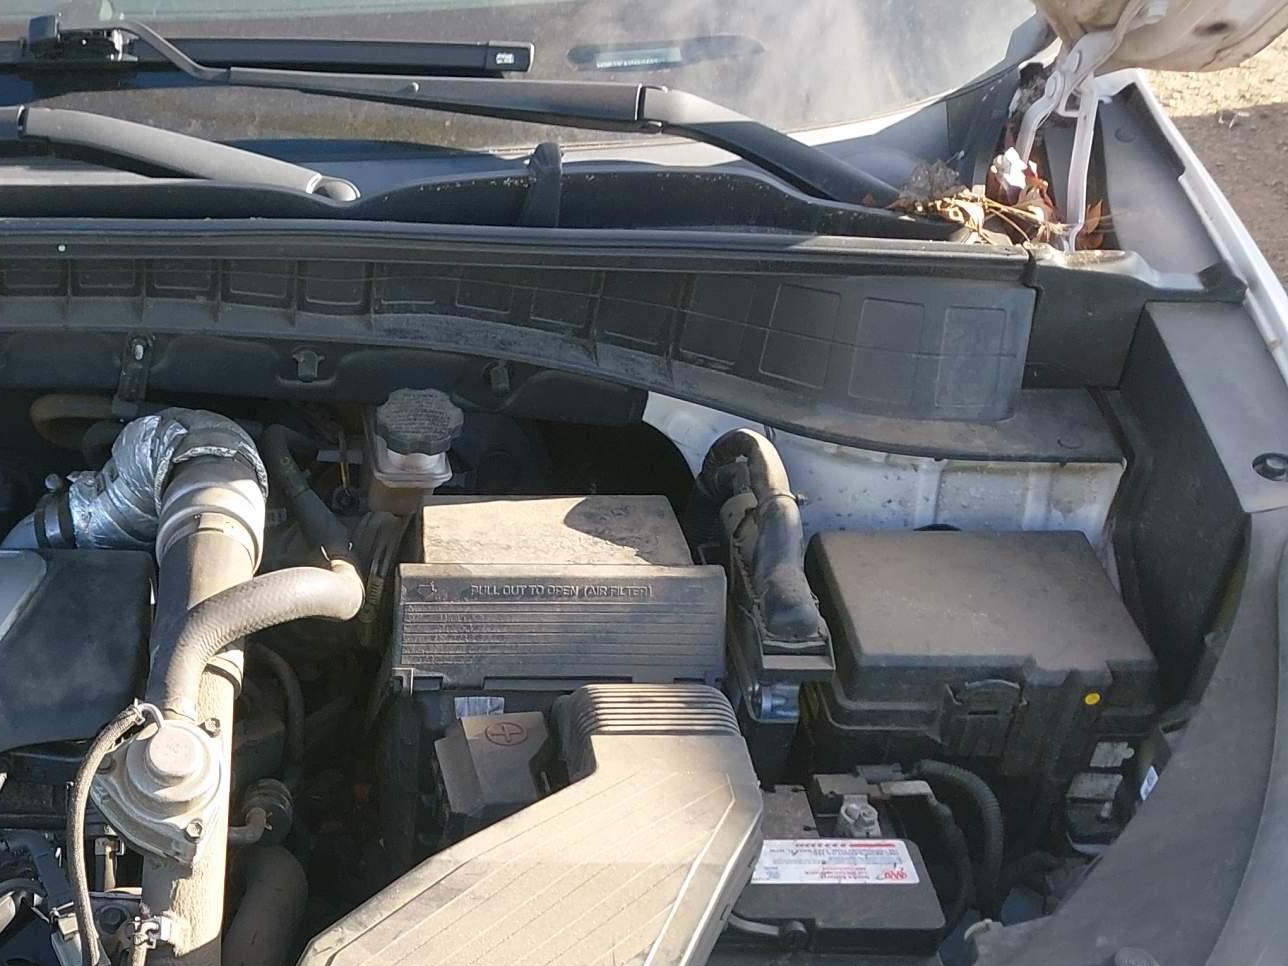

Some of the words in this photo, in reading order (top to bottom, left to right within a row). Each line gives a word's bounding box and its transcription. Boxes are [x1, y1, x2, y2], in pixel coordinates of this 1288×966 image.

[471, 585, 500, 597] PULL
[502, 585, 528, 597] OUT
[530, 585, 544, 597] TO
[547, 585, 579, 597] OPEN
[583, 585, 607, 597] (AIR
